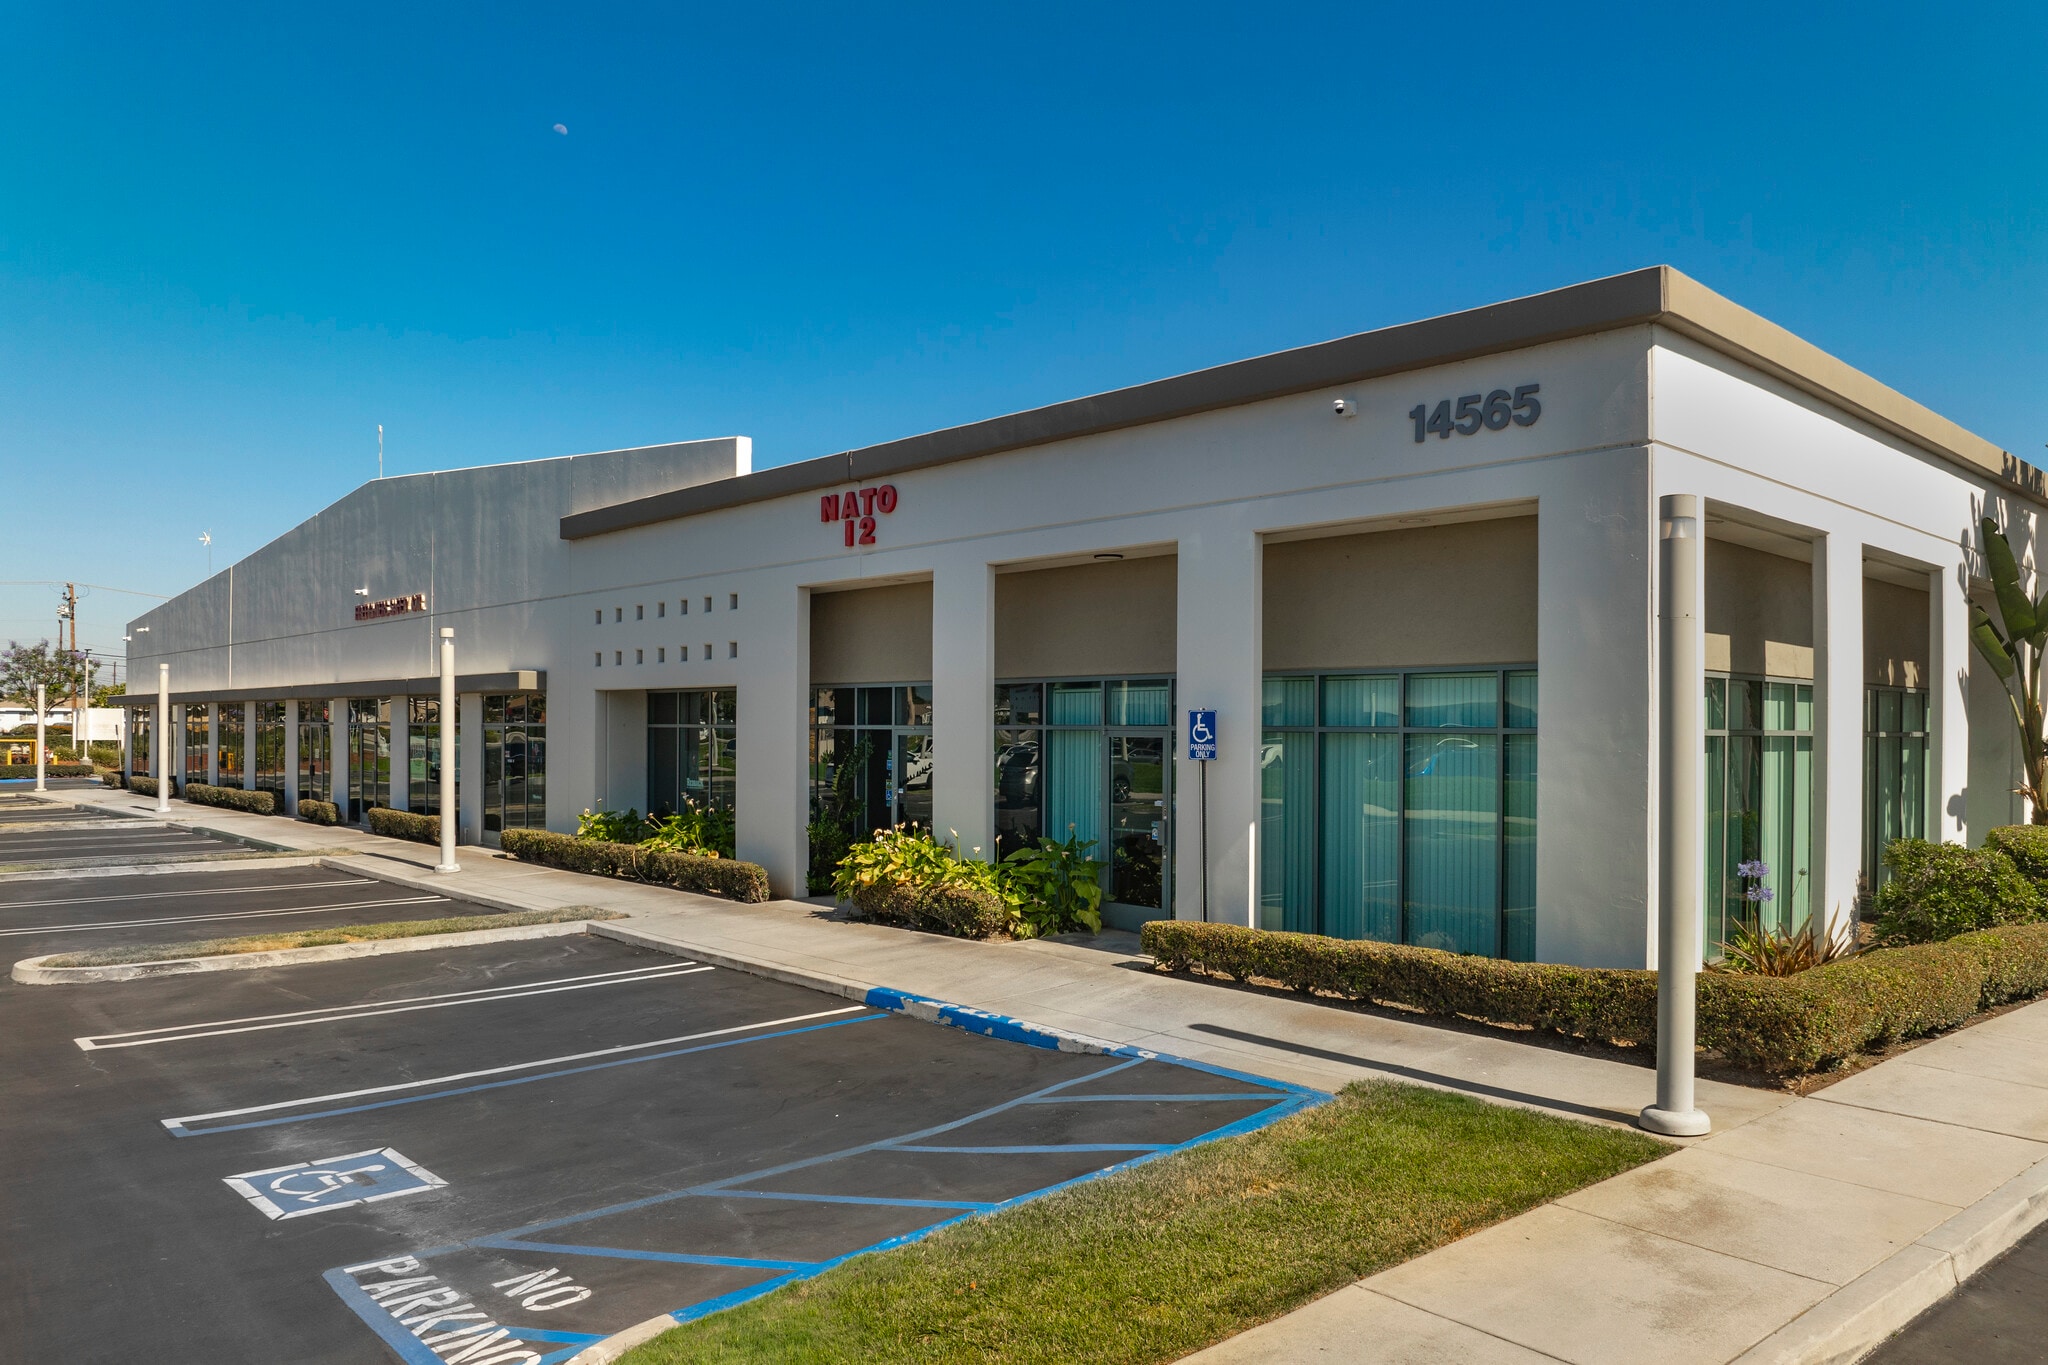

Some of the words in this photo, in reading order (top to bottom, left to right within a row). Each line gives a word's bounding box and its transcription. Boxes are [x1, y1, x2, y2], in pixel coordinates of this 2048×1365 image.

[1409, 384, 1541, 443] 14565
[821, 484, 898, 522] NATO
[844, 517, 876, 546] 12
[1190, 743, 1216, 751] PARKING
[1195, 750, 1211, 758] ONLY
[491, 1267, 592, 1311] NO
